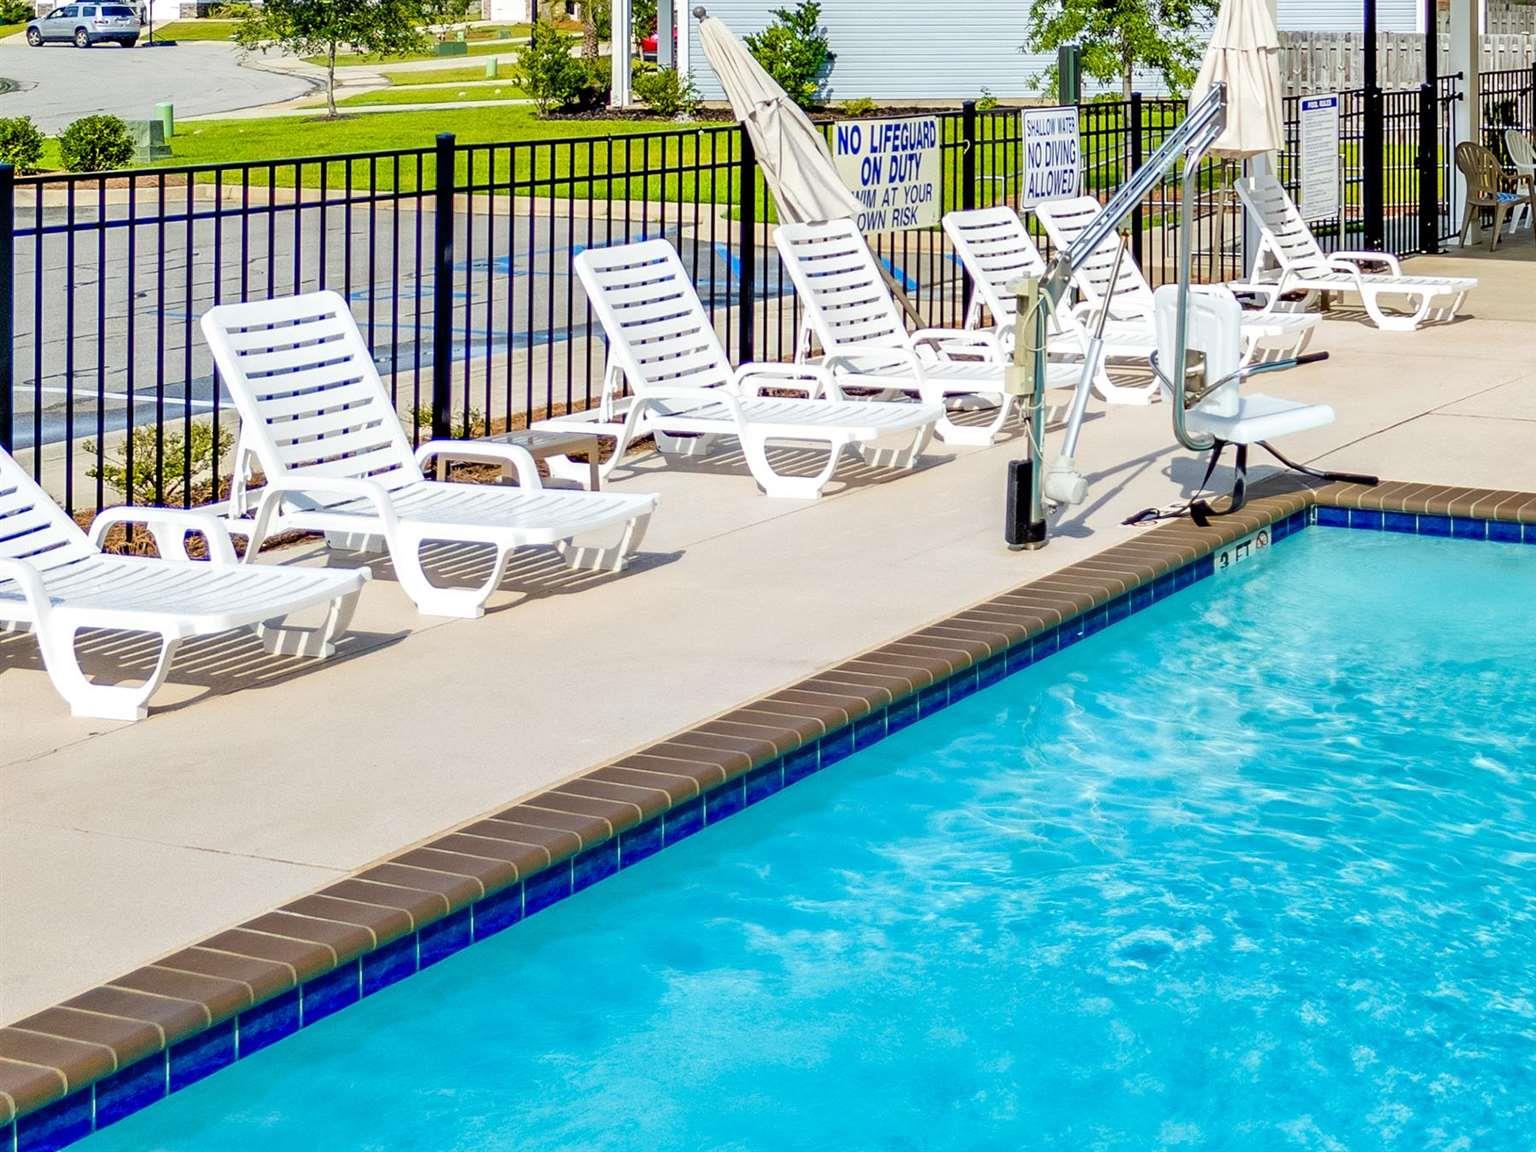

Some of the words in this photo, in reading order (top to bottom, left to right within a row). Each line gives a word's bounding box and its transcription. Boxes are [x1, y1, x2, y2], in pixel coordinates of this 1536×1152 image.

[838, 125, 861, 155] NO
[870, 121, 936, 153] LIFEGUARD
[1027, 118, 1056, 137] SHALLOW
[1058, 117, 1075, 134] WATER
[1028, 141, 1042, 168] NO
[1045, 139, 1076, 167] DIVING
[861, 156, 882, 186] ON
[889, 153, 922, 184] DUTY
[851, 189, 877, 209] WIM
[882, 187, 898, 207] AT
[904, 183, 933, 204] YOUR
[1028, 169, 1075, 199] ALLOWED
[857, 209, 886, 231] OWN
[892, 206, 918, 227] RISK
[1236, 539, 1251, 561] FT
